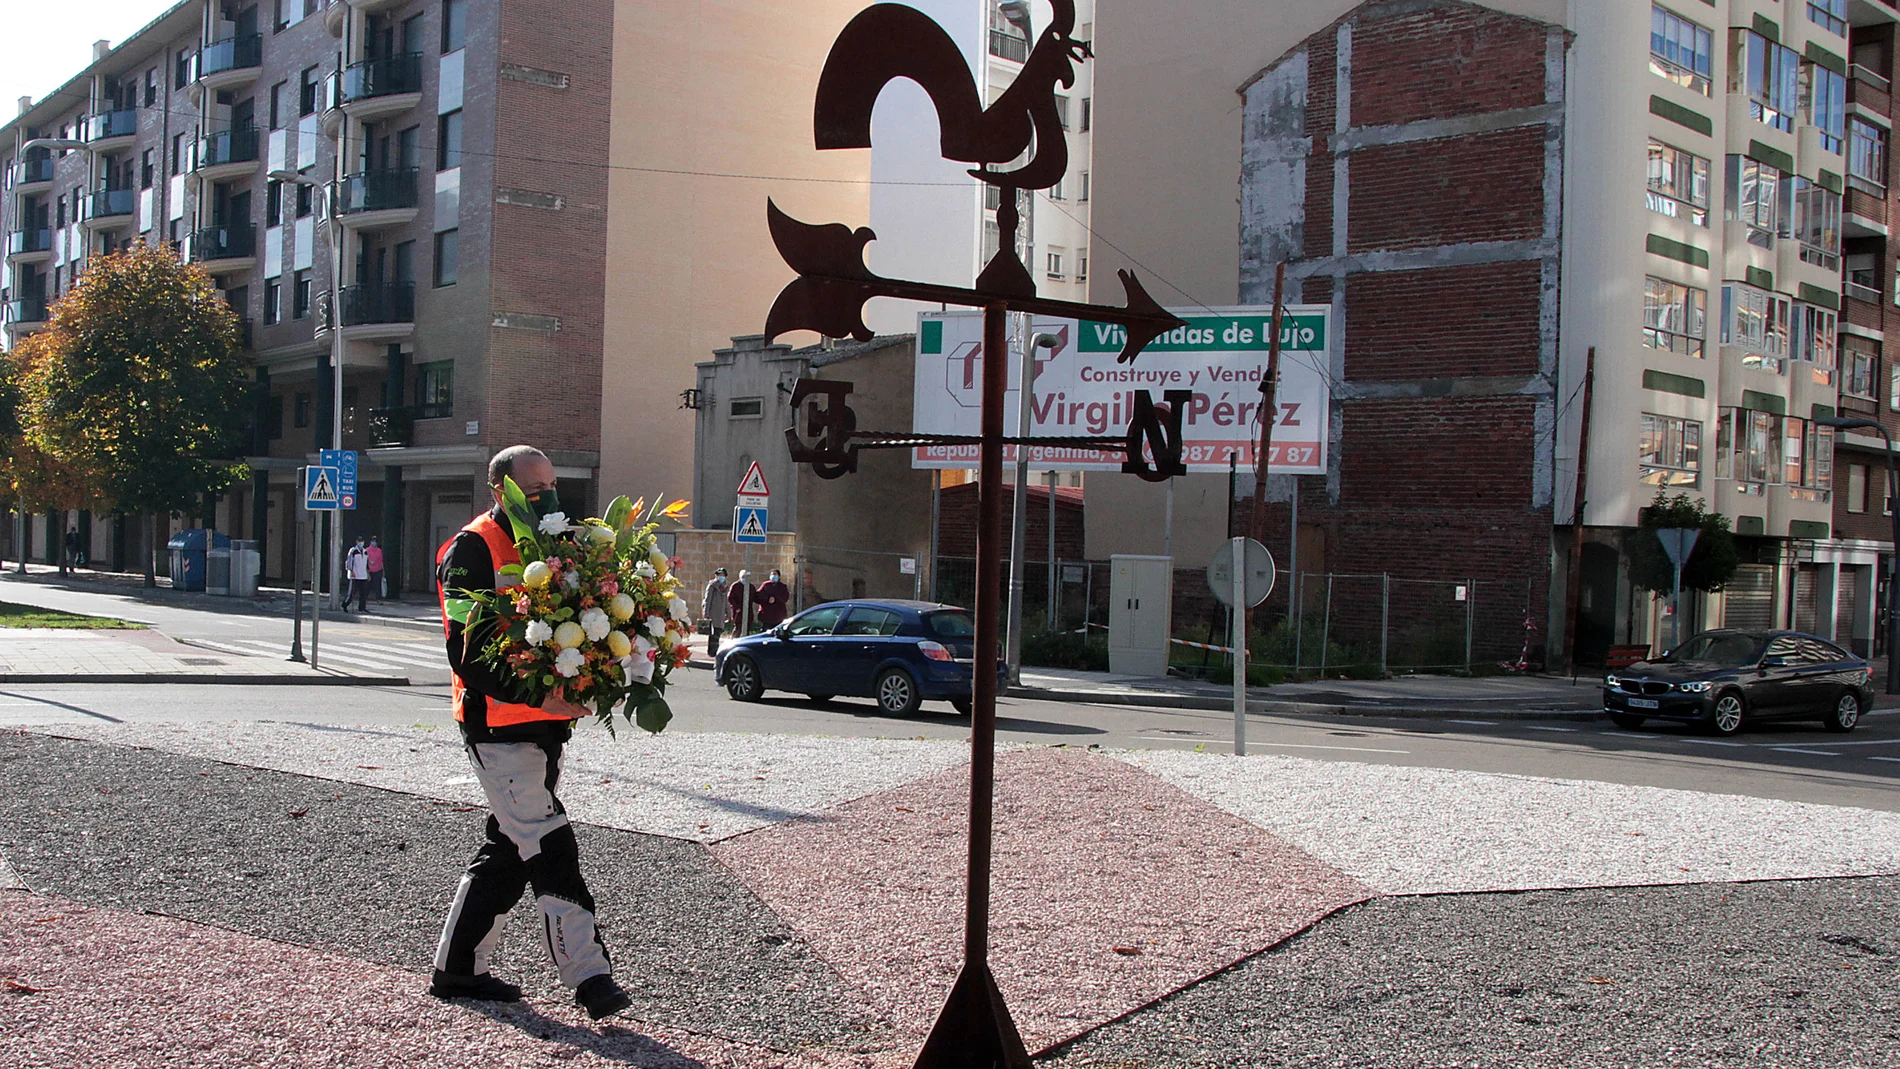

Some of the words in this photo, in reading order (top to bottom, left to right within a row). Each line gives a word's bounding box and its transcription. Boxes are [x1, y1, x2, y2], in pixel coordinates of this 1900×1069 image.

[1094, 323, 1215, 345] Vivndas
[1222, 321, 1254, 344] de
[1262, 321, 1315, 349] Lujo
[1080, 365, 1182, 387] Construye
[1188, 370, 1201, 387] y
[1031, 390, 1171, 435] Virgil
[1121, 389, 1192, 476] N
[1012, 445, 1106, 462] rgentina,
[1221, 446, 1244, 462] 21
[1286, 447, 1314, 463] 87
